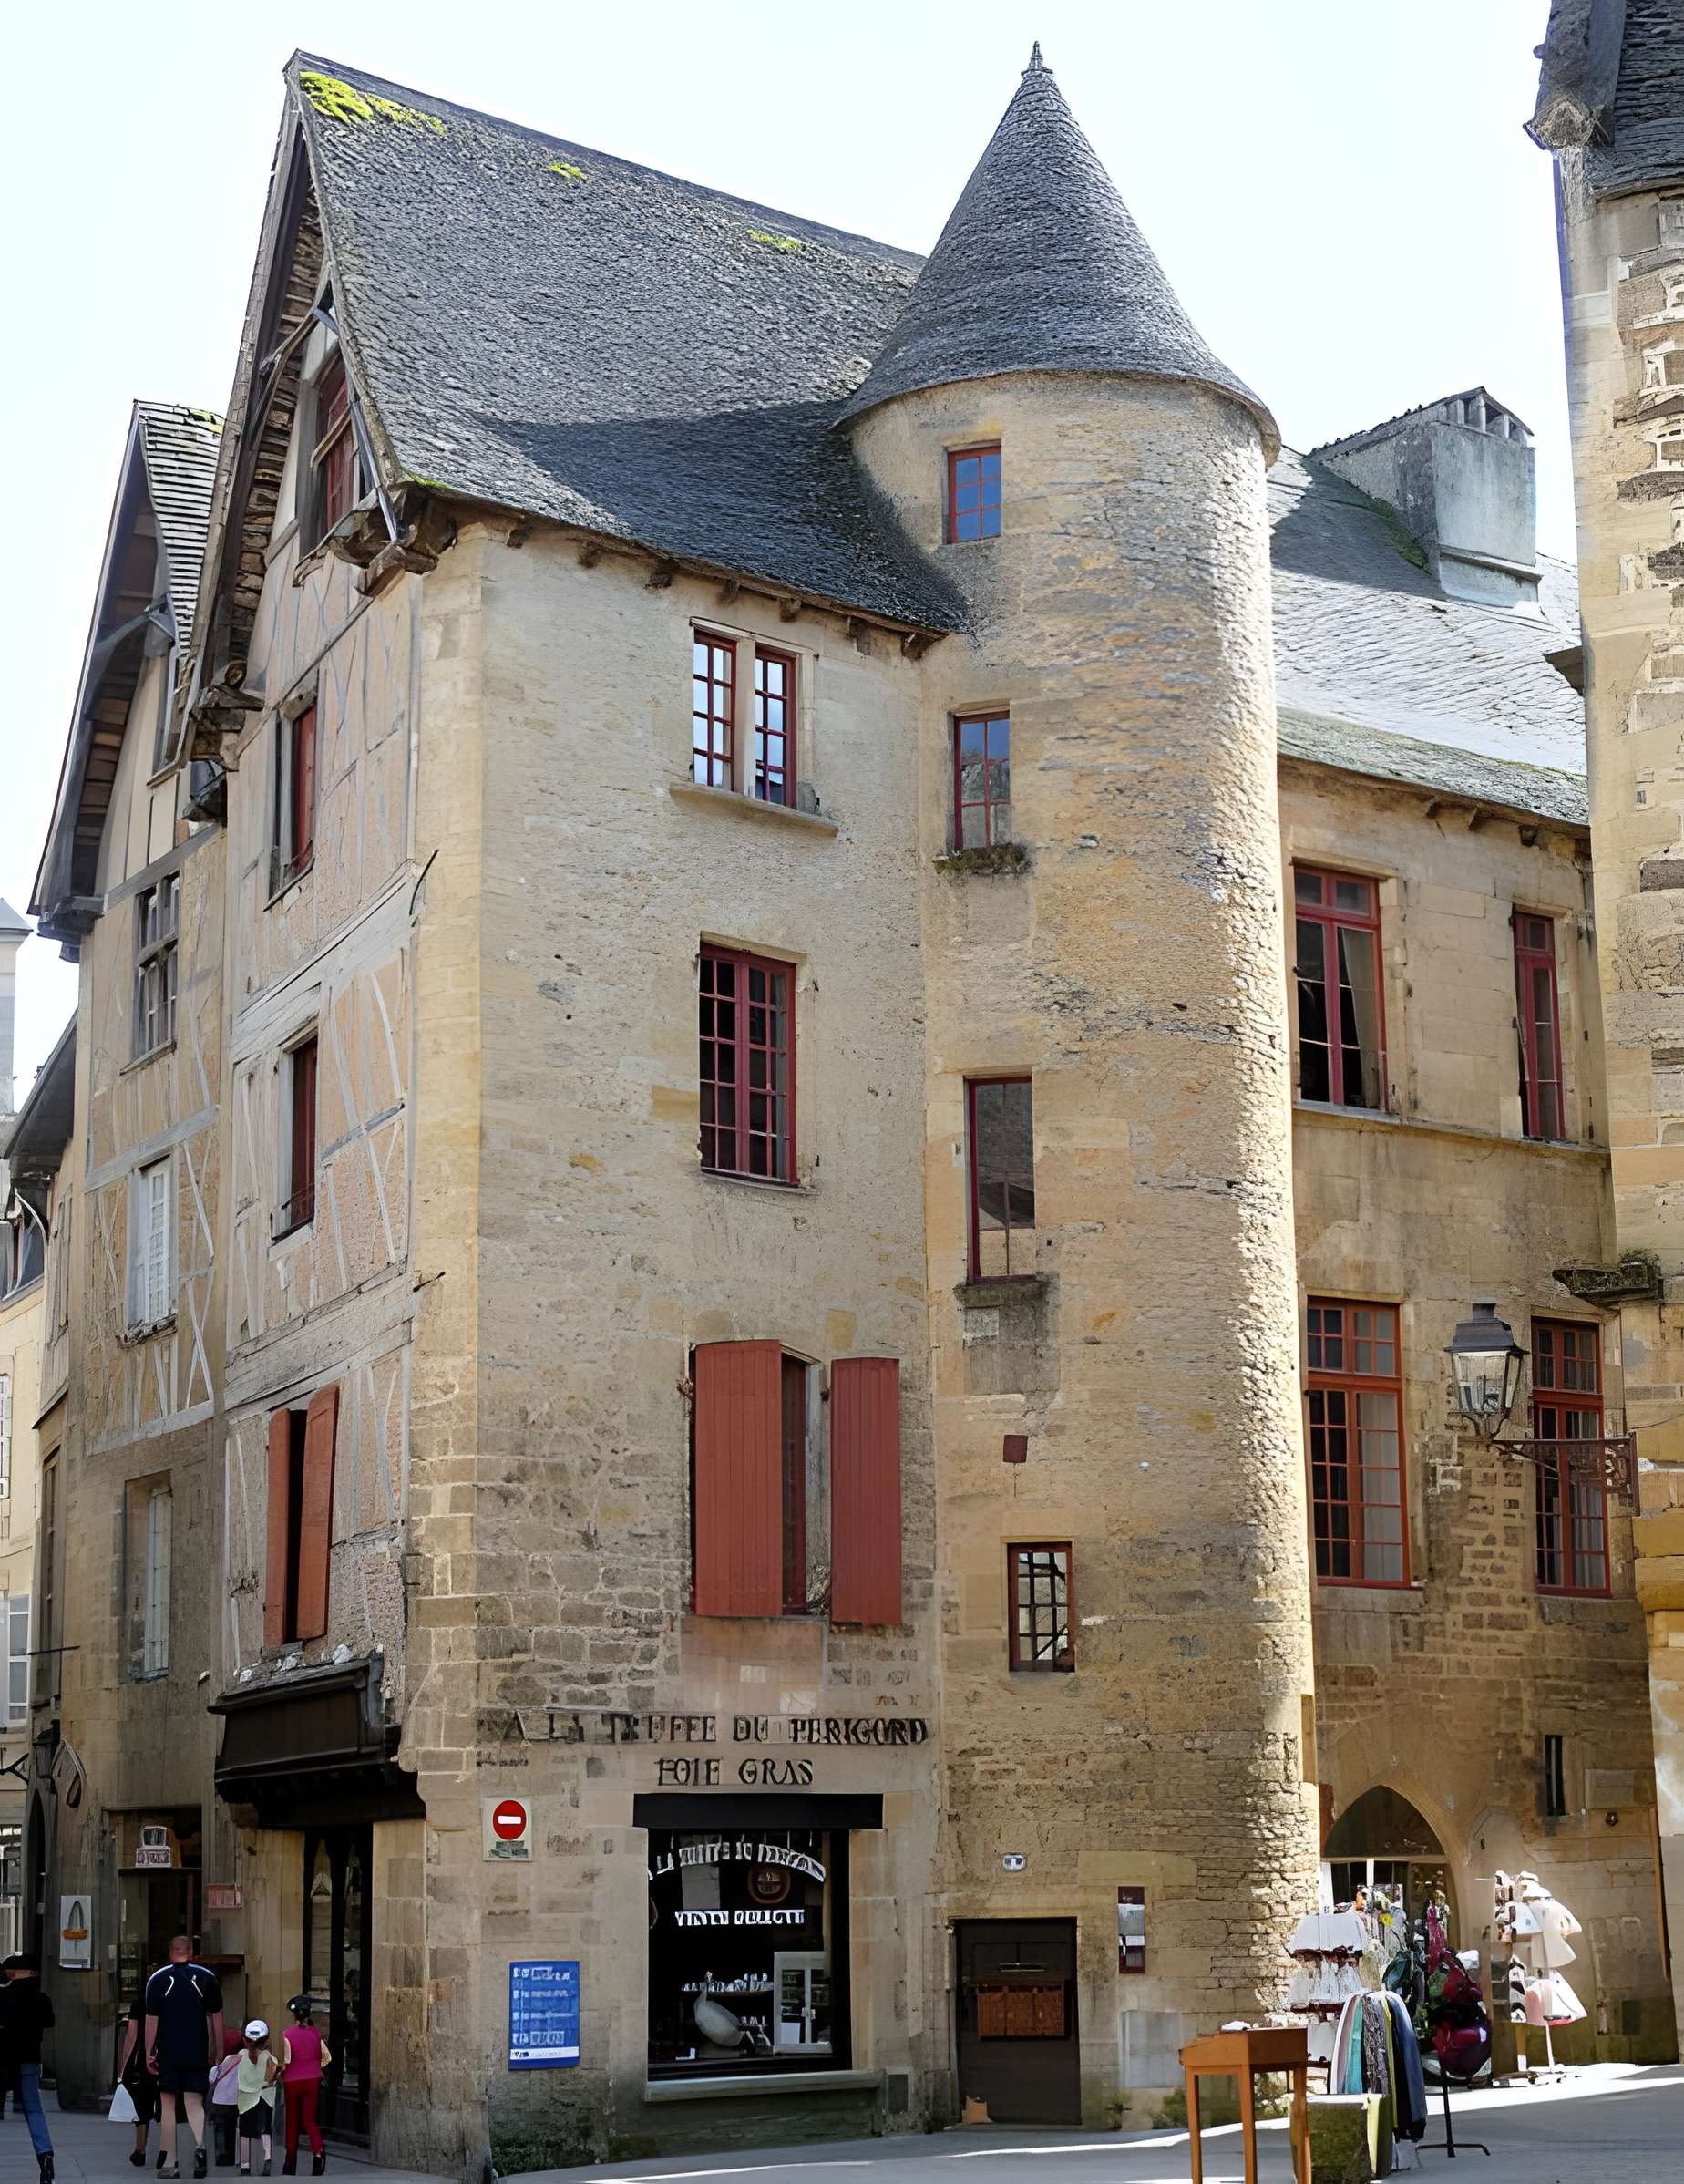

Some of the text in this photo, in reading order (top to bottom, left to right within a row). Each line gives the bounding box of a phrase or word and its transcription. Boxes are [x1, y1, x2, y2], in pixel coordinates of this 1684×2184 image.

[733, 1715, 769, 1743] DU
[654, 1758, 814, 1786] FOIE GRAS
